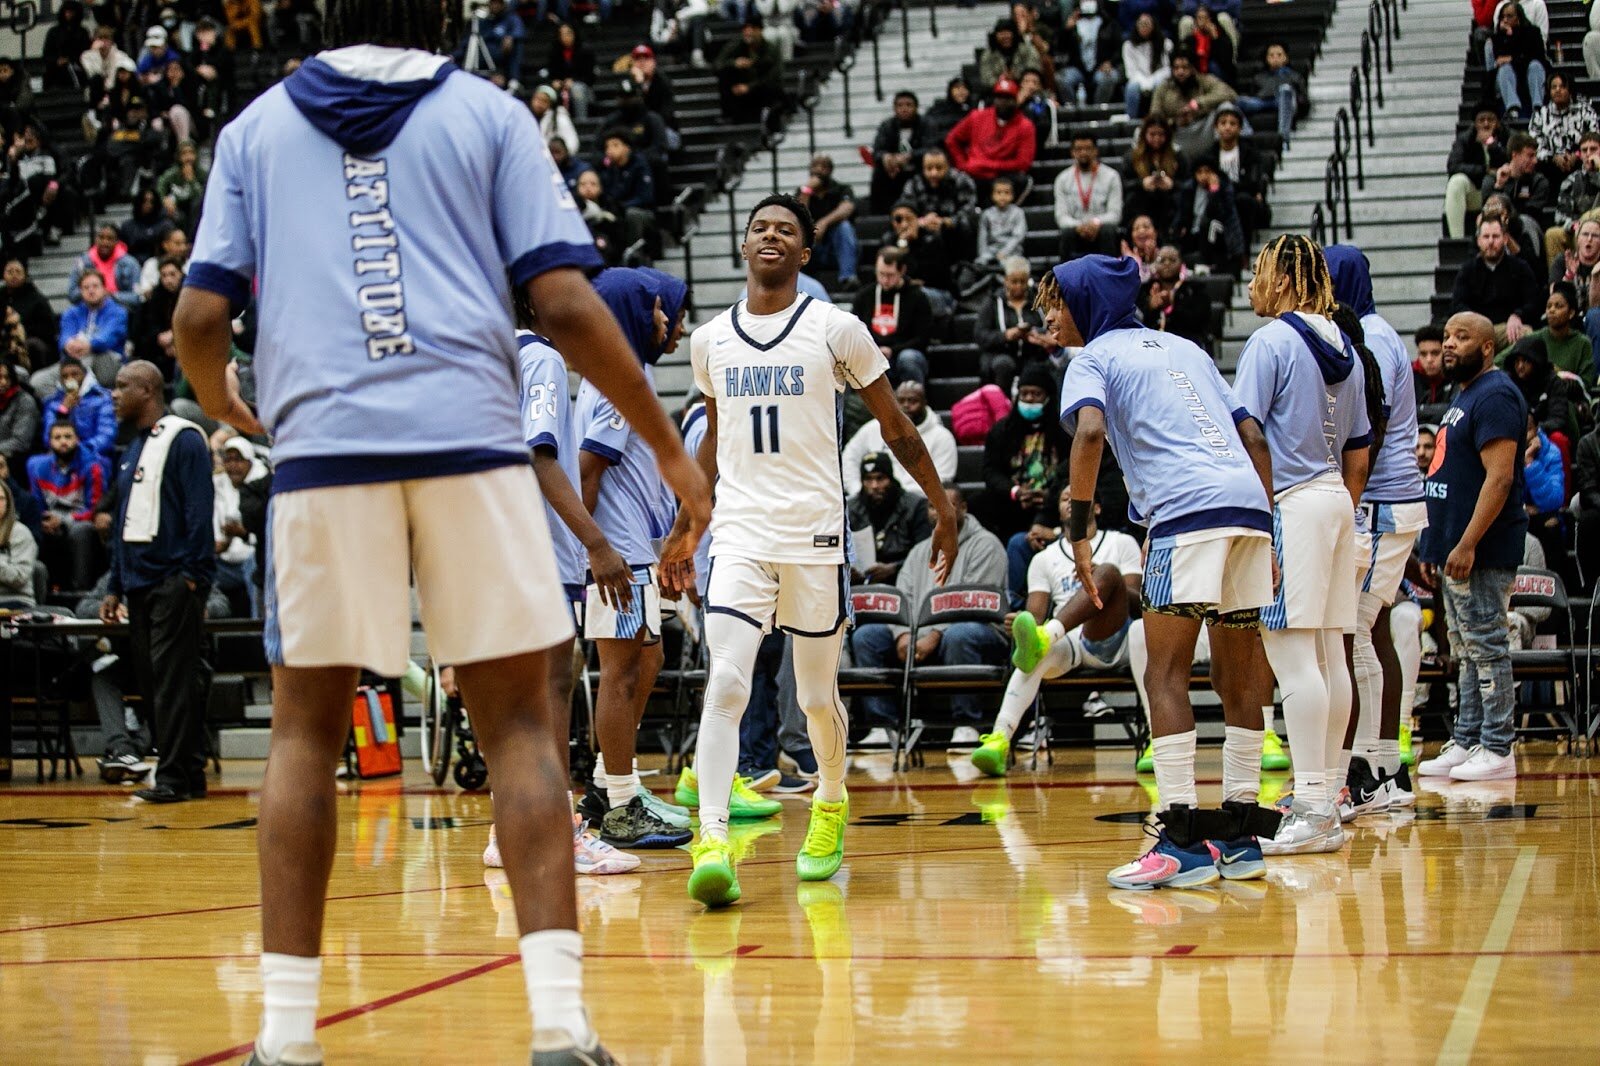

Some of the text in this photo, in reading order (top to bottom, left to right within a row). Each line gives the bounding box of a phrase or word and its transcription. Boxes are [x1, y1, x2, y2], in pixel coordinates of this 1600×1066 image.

[343, 152, 415, 361] ATTITUDE
[528, 380, 558, 421] 23
[725, 365, 804, 397] HAWKS
[749, 404, 780, 454] 11
[1166, 368, 1235, 459] ATTITUDE
[932, 591, 1000, 614] BOBCATS
[1513, 576, 1555, 596] CATS
